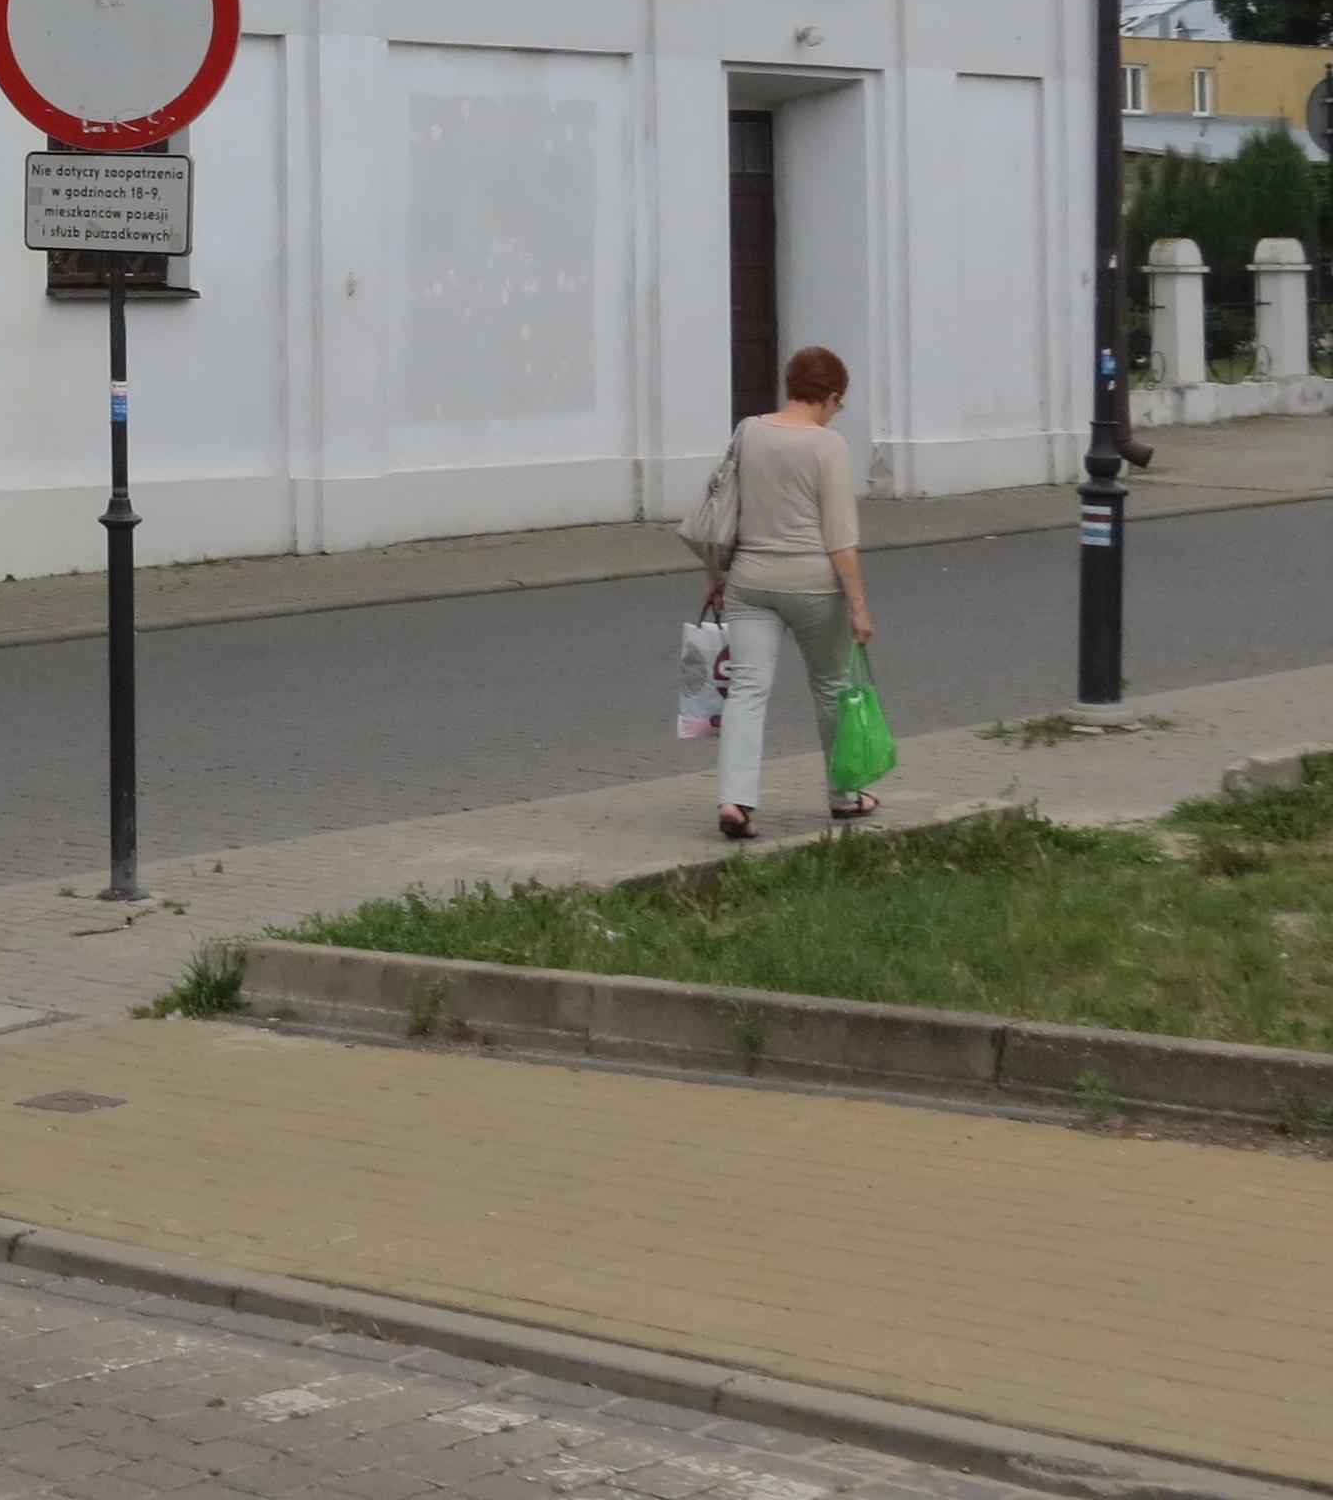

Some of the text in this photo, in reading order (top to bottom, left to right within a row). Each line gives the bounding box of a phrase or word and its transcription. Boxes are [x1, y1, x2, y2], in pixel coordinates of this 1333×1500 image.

[31, 164, 184, 181] Nie dotyczy zaopatrzenia
[51, 188, 61, 197] w
[65, 187, 126, 200] godzinach
[45, 206, 169, 223] mieszkańców posesji
[49, 228, 80, 239] służb
